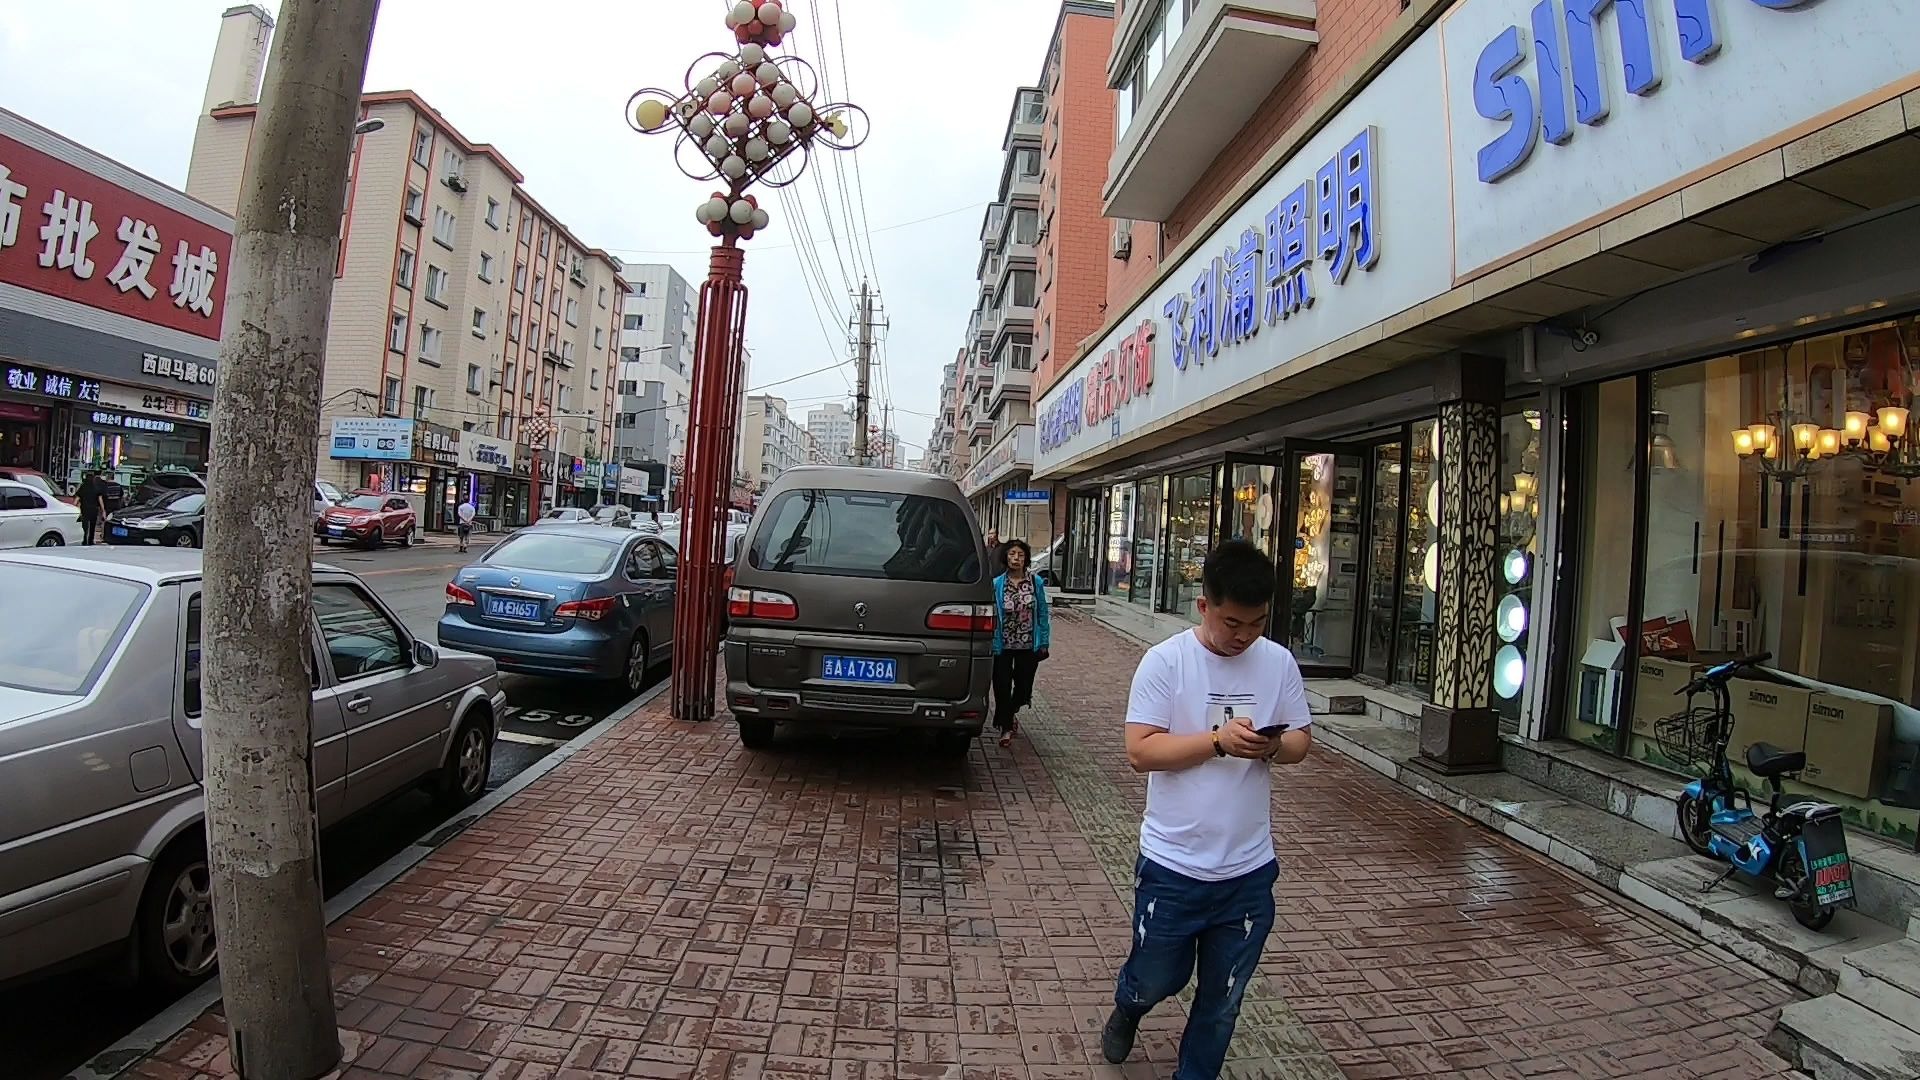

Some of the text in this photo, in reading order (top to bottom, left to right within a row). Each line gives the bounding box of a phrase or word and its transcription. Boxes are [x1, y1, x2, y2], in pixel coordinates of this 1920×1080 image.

[1473, 0, 1832, 183] sim
[1163, 124, 1380, 371] 飞利浦照明
[8, 368, 37, 391] 敬业
[44, 375, 73, 397] 诚信
[143, 352, 216, 385] 西四马路60
[1749, 688, 1778, 705] simon
[1812, 701, 1844, 719] simon
